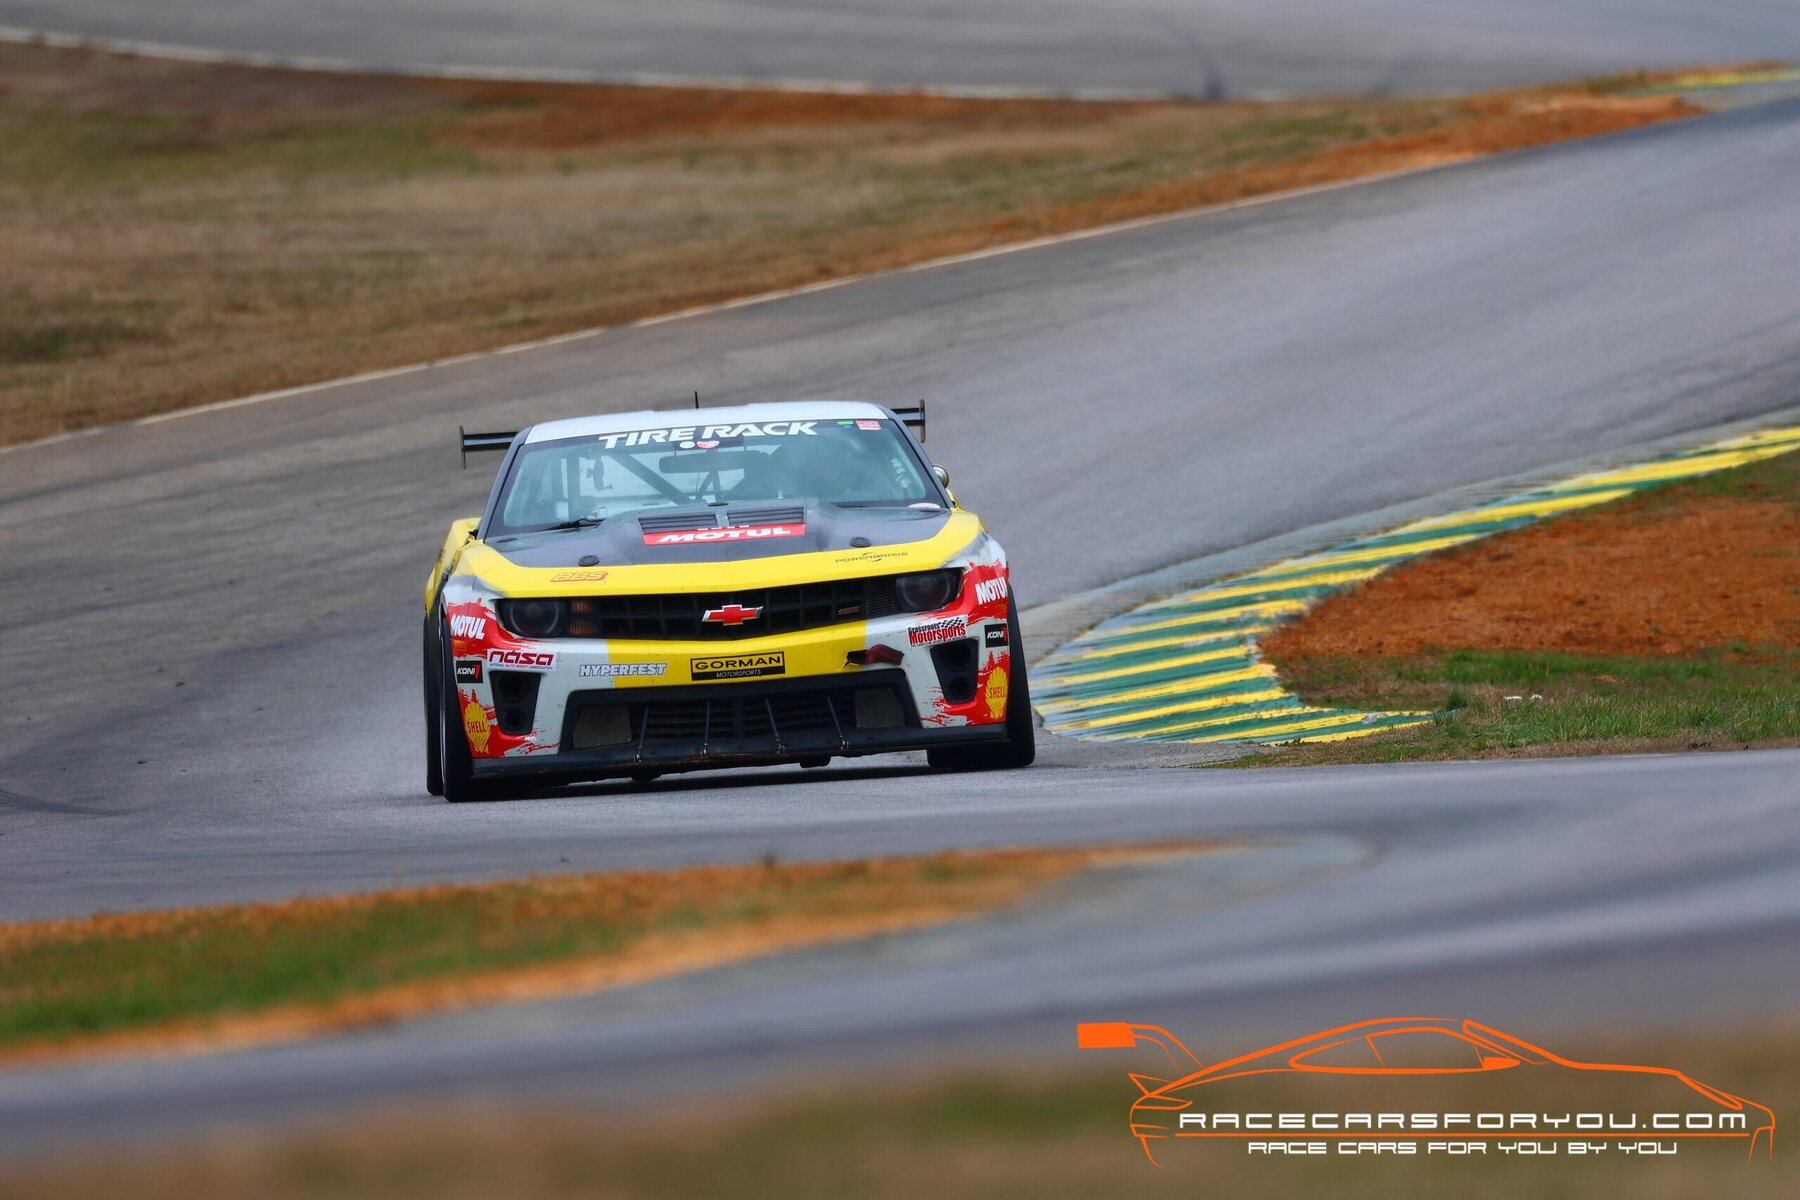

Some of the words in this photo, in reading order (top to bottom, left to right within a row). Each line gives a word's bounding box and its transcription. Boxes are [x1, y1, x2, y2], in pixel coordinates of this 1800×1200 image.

[599, 427, 696, 449] TIRE
[701, 422, 818, 440] RACK
[657, 526, 792, 543] MOTUL
[551, 571, 608, 582] BBS
[974, 576, 1008, 606] MOTU
[450, 614, 487, 640] MOTUL
[908, 622, 941, 633] Grassroots
[909, 624, 966, 645] Motorsports
[694, 655, 781, 670] GORMAN
[457, 667, 476, 675] KONI
[579, 663, 668, 677] HYPERFEST
[716, 669, 761, 678] MOTORSPORTS
[989, 686, 1006, 700] SHELL
[467, 721, 487, 733] SHELL
